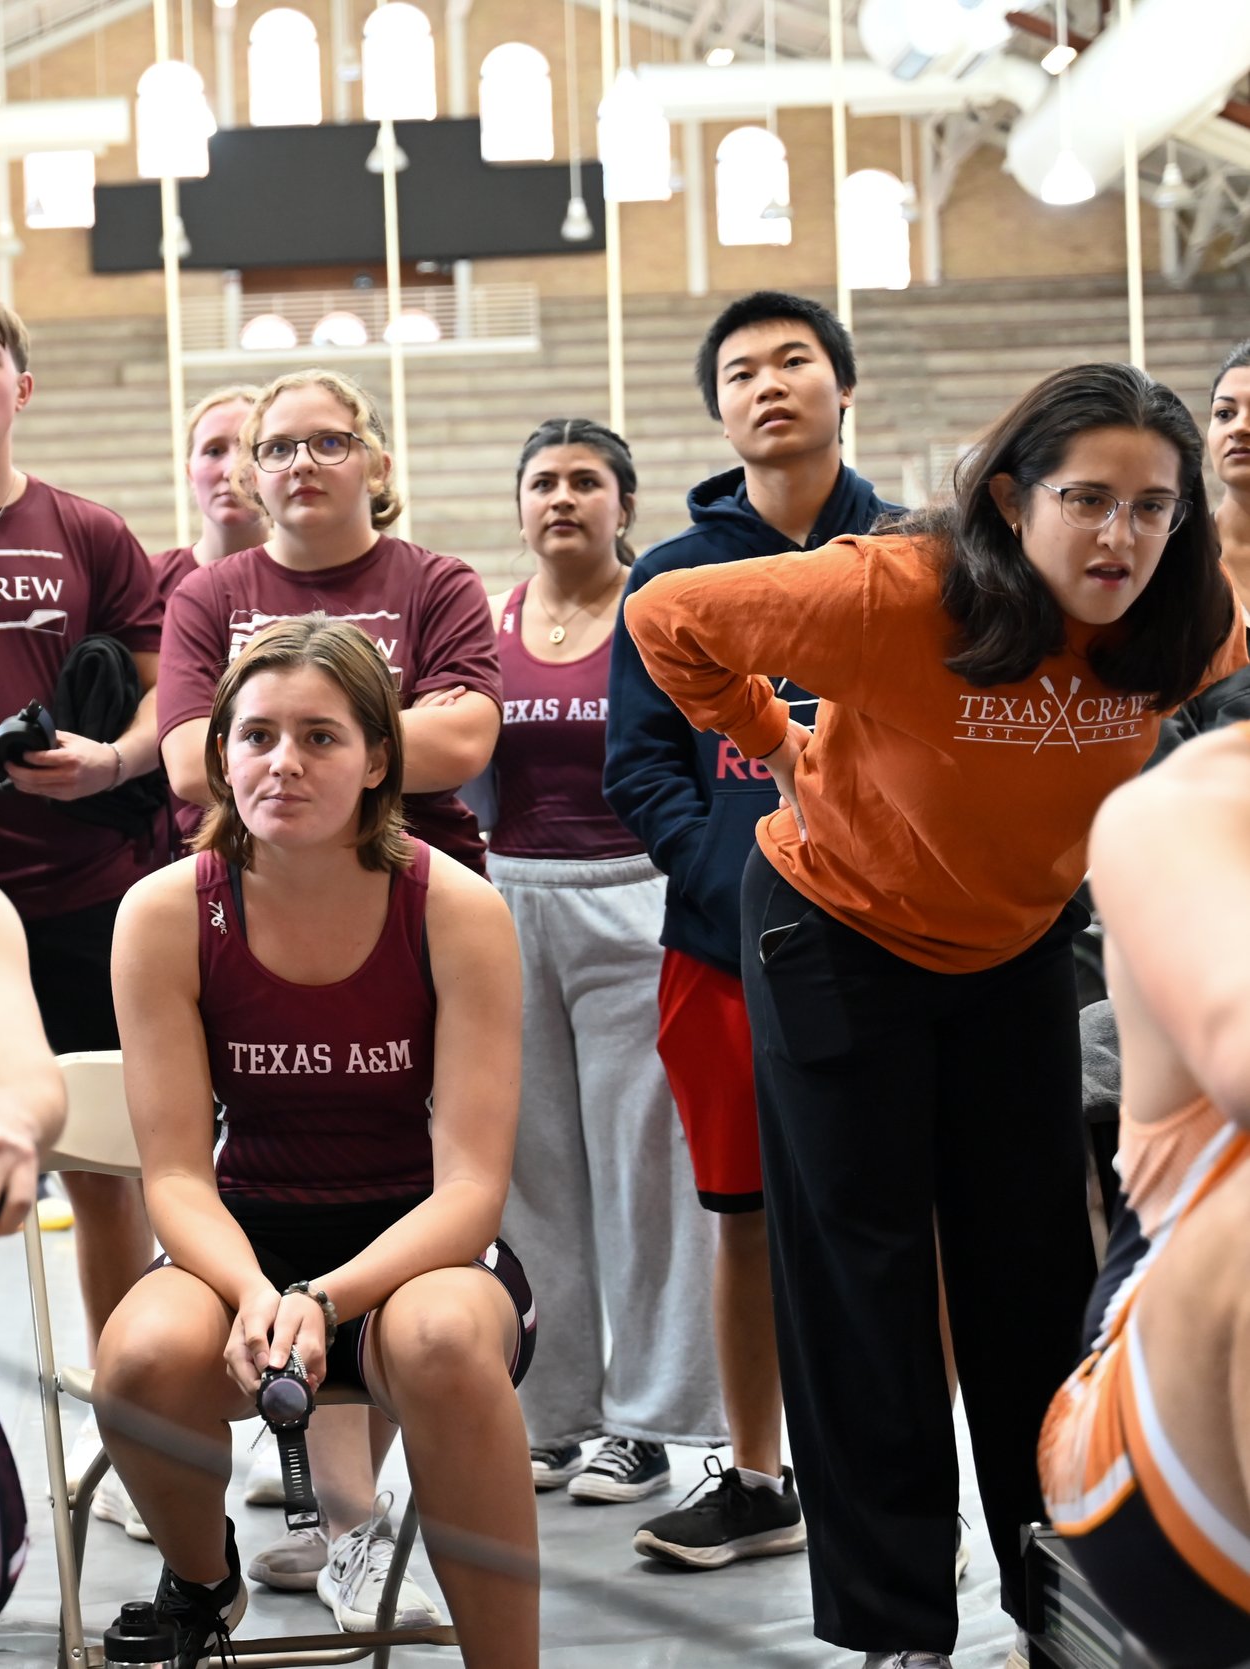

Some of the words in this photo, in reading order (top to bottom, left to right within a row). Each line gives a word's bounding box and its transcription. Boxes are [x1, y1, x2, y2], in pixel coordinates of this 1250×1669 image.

[502, 698, 560, 724] EXAS
[959, 694, 1052, 724] TEXAS
[1076, 695, 1151, 723] CREW
[967, 726, 1024, 741] EST.
[1091, 723, 1136, 740] 1969
[227, 1041, 333, 1075] TEXAS
[345, 1038, 414, 1074] A&M
